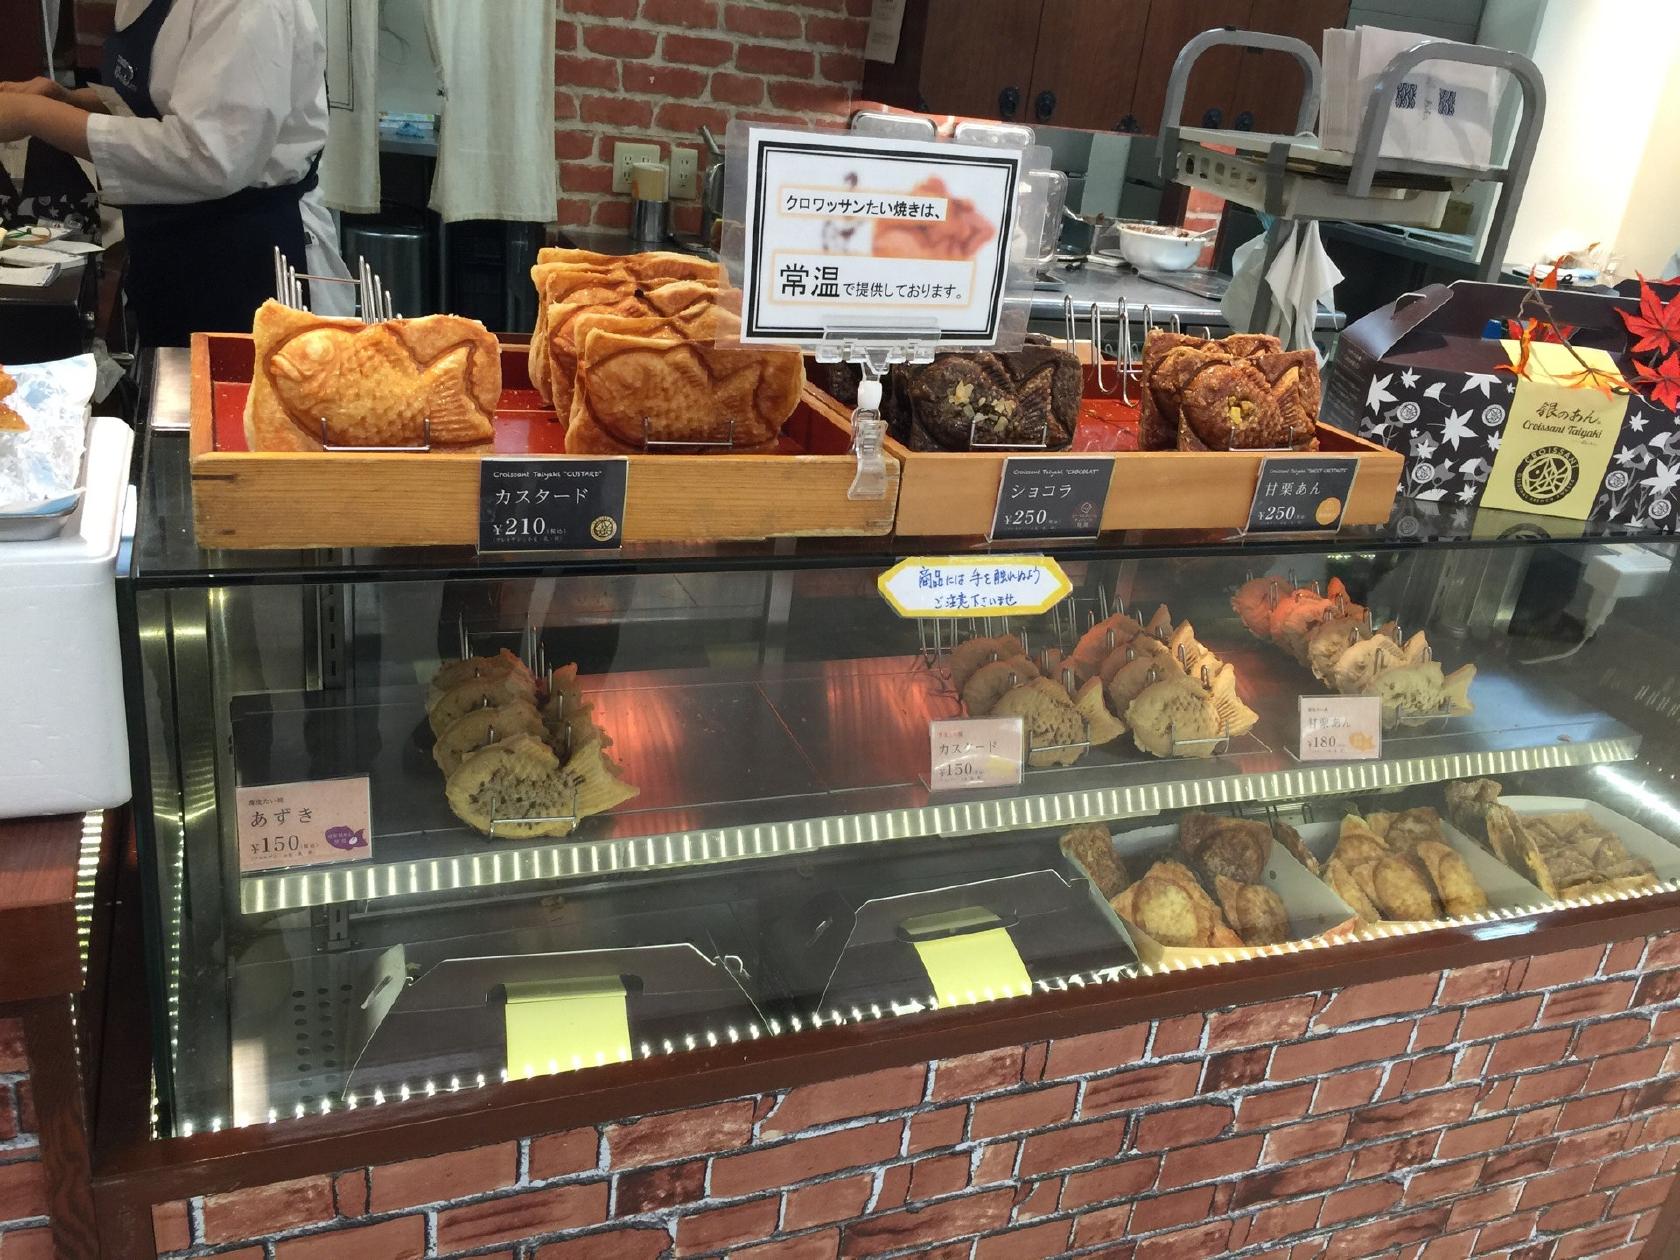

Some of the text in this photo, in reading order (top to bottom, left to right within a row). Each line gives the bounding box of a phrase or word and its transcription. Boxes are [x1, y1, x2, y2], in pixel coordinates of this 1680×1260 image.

[786, 194, 940, 219] クロワッサンたい焼きは、
[780, 263, 962, 300] 常温で提供しております。
[1522, 420, 1603, 438] Croissant Taiyaki
[533, 471, 561, 480] Taiyaki
[495, 488, 589, 505] カスタード
[1011, 484, 1072, 499] ショコラ
[1265, 482, 1320, 497] 甘栗あん
[1005, 509, 1047, 525] ¥250
[1258, 506, 1296, 520] ¥250
[493, 517, 546, 536] ¥210
[250, 807, 313, 828] あずき
[251, 835, 299, 854] ¥150
